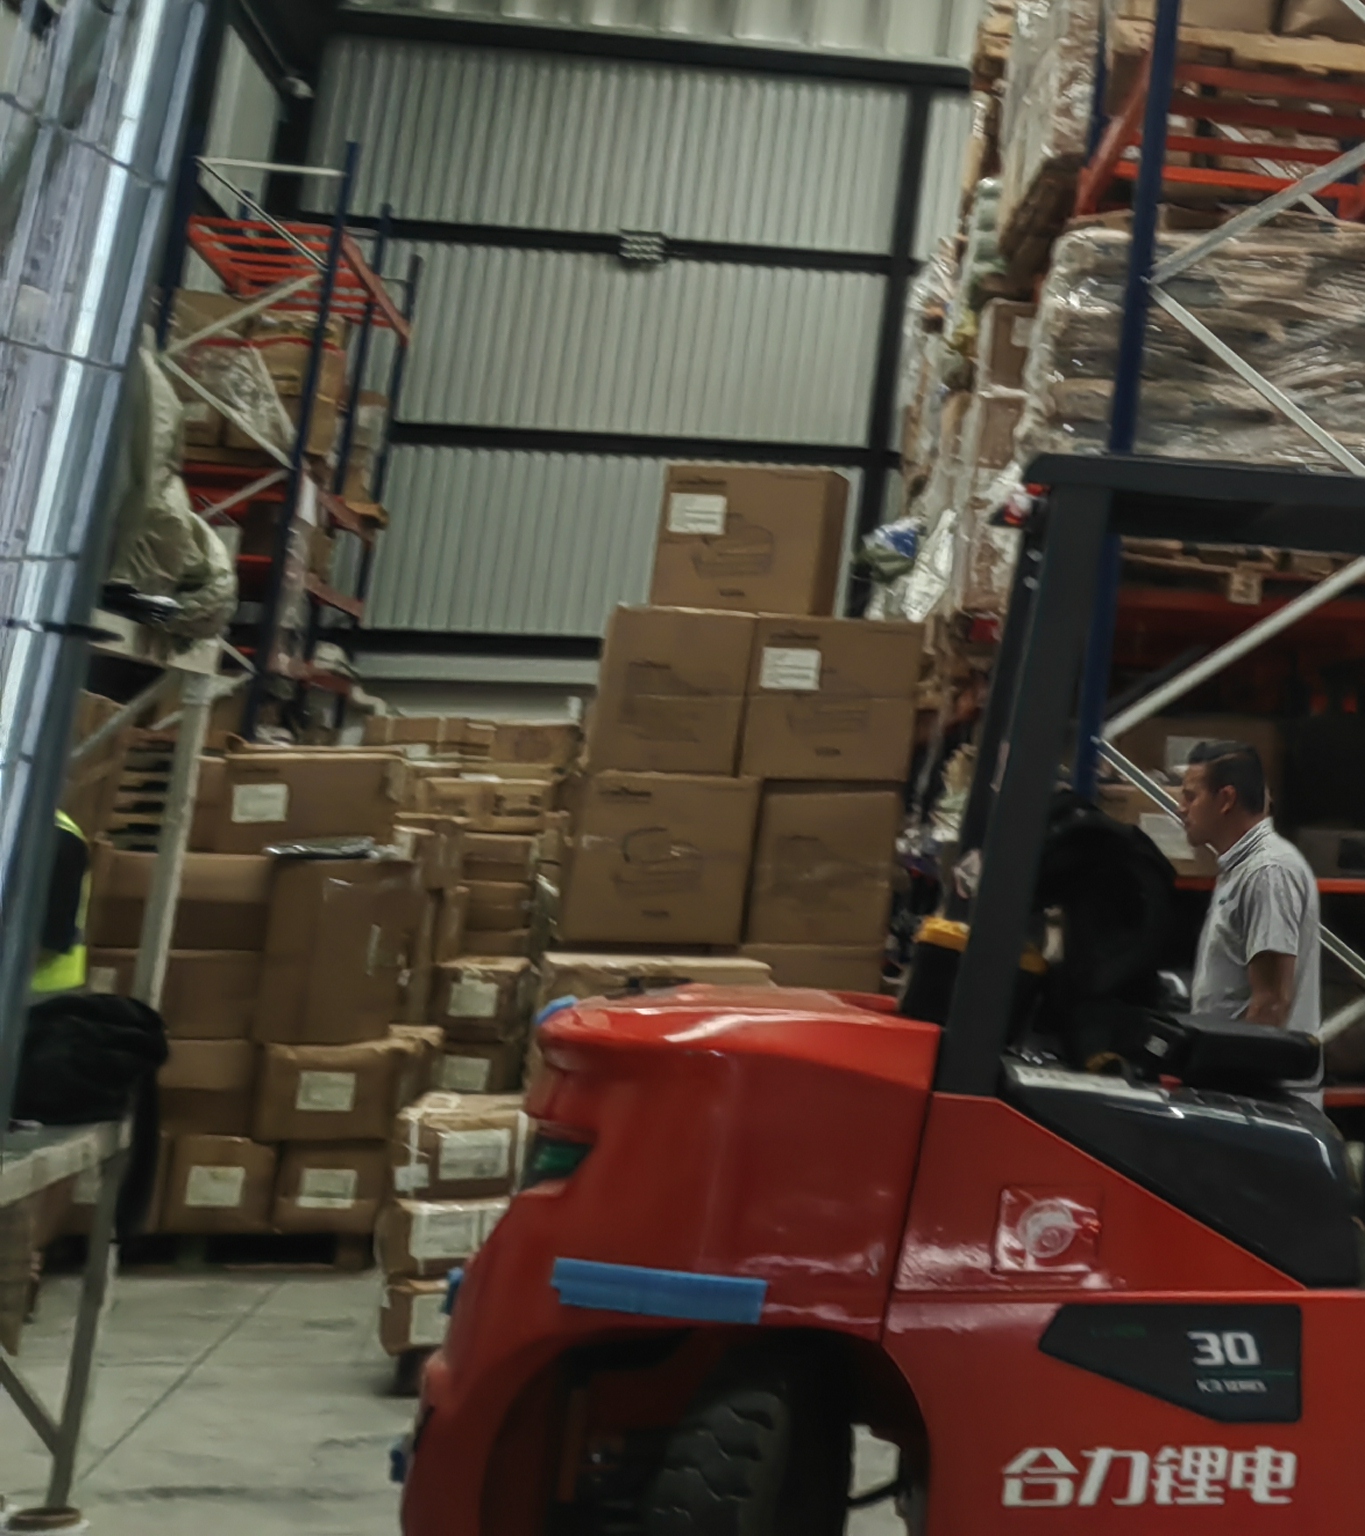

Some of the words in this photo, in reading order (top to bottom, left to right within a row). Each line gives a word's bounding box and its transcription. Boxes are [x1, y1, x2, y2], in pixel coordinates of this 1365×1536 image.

[1187, 1331, 1261, 1366] 30
[1001, 1445, 1297, 1507] 合力锂电
